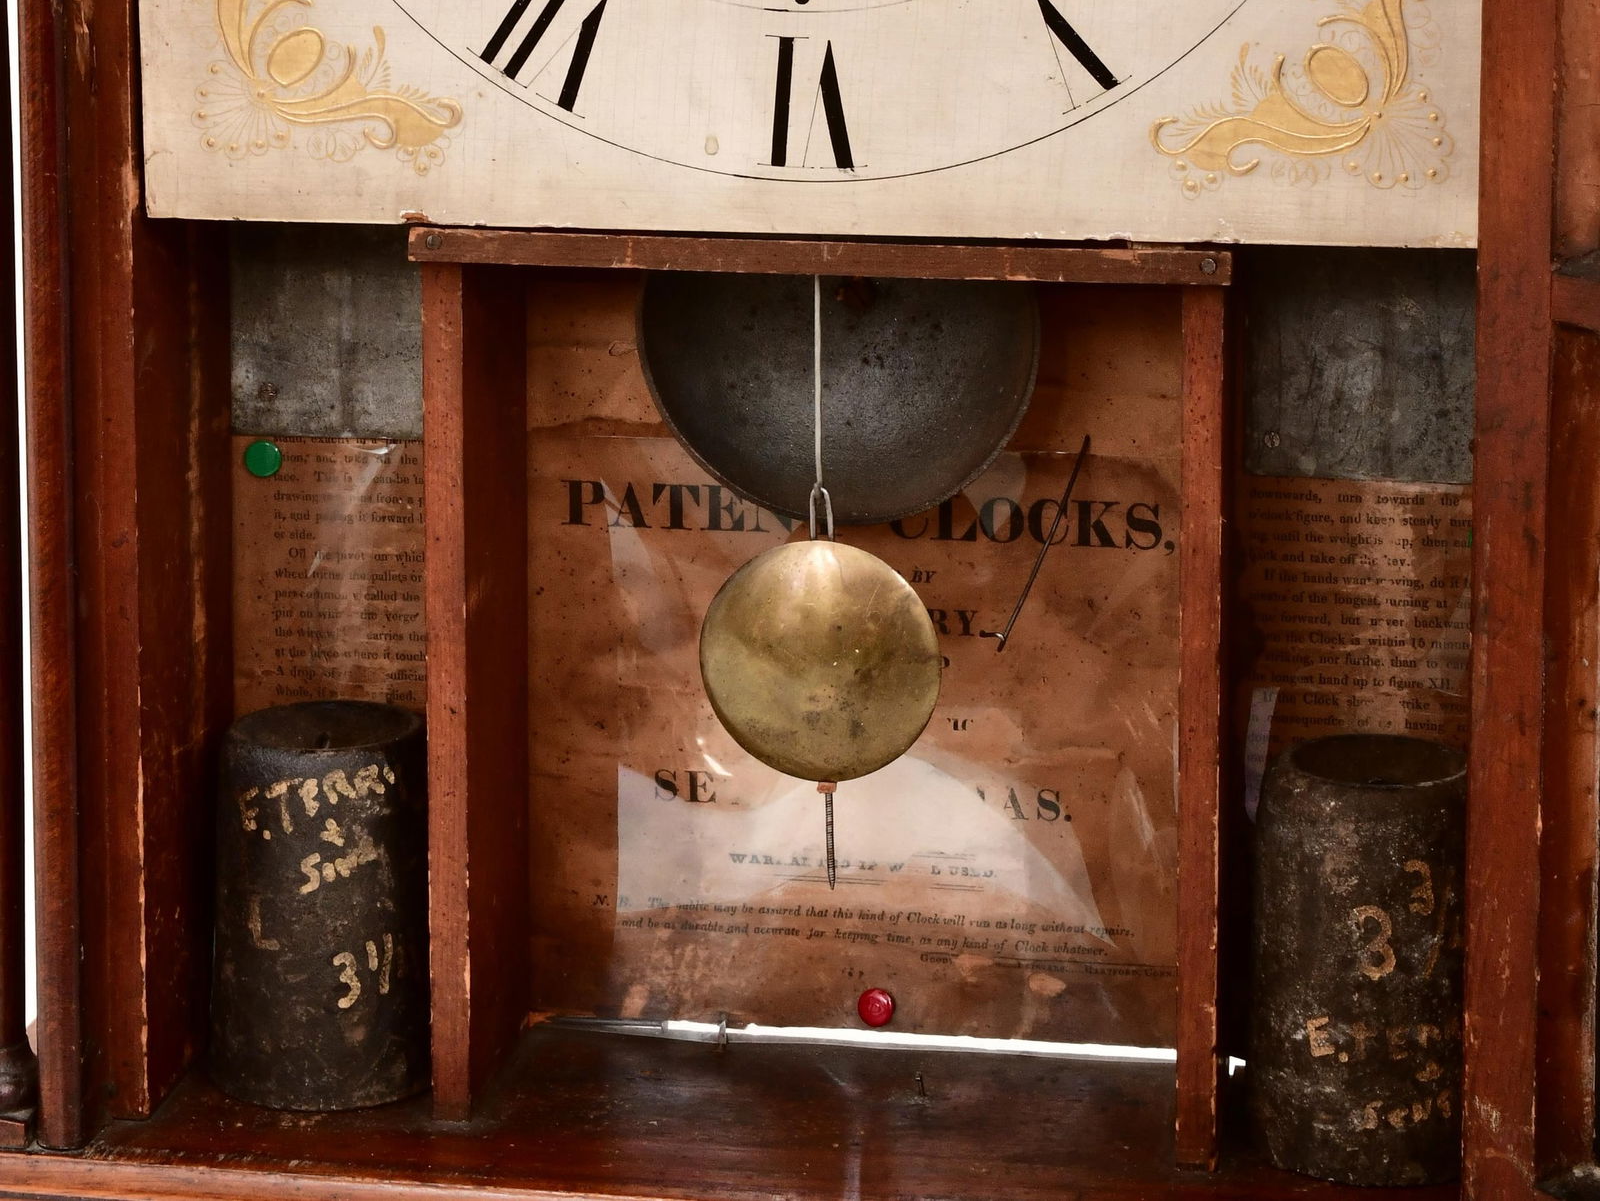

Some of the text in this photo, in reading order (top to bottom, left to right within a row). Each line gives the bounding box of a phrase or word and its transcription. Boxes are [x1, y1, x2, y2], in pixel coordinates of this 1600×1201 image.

[758, 35, 868, 172] VI
[400, 454, 418, 465] the
[561, 479, 802, 533] PATE
[1338, 494, 1362, 503] turn
[1377, 495, 1425, 505] towards
[1441, 494, 1459, 506] the
[371, 511, 414, 524] forward
[1296, 511, 1334, 525] figure,
[1340, 513, 1360, 524] and
[1402, 517, 1442, 529] steady
[288, 529, 316, 540] side.
[1305, 532, 1324, 543] the
[1283, 552, 1357, 564] and take off
[369, 571, 407, 584] pallets
[911, 570, 937, 584] BY
[1303, 572, 1338, 584] hands
[1430, 577, 1444, 588] do
[364, 590, 397, 602] called
[402, 591, 420, 602] the
[1308, 593, 1328, 604] the
[1280, 613, 1332, 626] forward,
[1341, 615, 1360, 626] but
[1309, 632, 1345, 645] Clock
[1350, 635, 1360, 645] is
[1368, 637, 1405, 647] within
[1320, 655, 1438, 669] nor than to
[1318, 673, 1349, 686] hand
[1353, 677, 1368, 689] up
[1373, 677, 1384, 687] to
[1389, 677, 1424, 690] figure
[1303, 694, 1339, 706] Clock
[1404, 719, 1444, 732] having
[593, 894, 610, 907] N.
[714, 905, 738, 917] may
[742, 903, 754, 915] be
[758, 906, 801, 918] assured
[806, 905, 829, 918] that
[833, 907, 853, 920] this
[858, 909, 885, 921] kind
[889, 910, 903, 924] of
[907, 911, 940, 925] Clock
[943, 914, 965, 927] will
[995, 920, 1007, 930] as
[1010, 918, 1036, 934] long
[1041, 921, 1085, 934] without
[1089, 924, 1135, 939] repairs,
[622, 918, 643, 929] and
[648, 917, 660, 929] be
[680, 919, 723, 932] durable
[726, 922, 749, 935] and
[754, 926, 800, 936] accurate
[806, 927, 826, 940] for
[834, 928, 879, 943] keeping
[887, 931, 915, 946] time,
[936, 936, 958, 950] any
[962, 936, 989, 950] kind
[994, 939, 1008, 952] of
[1015, 939, 1048, 953] Clock
[1053, 942, 1108, 957] whatever.
